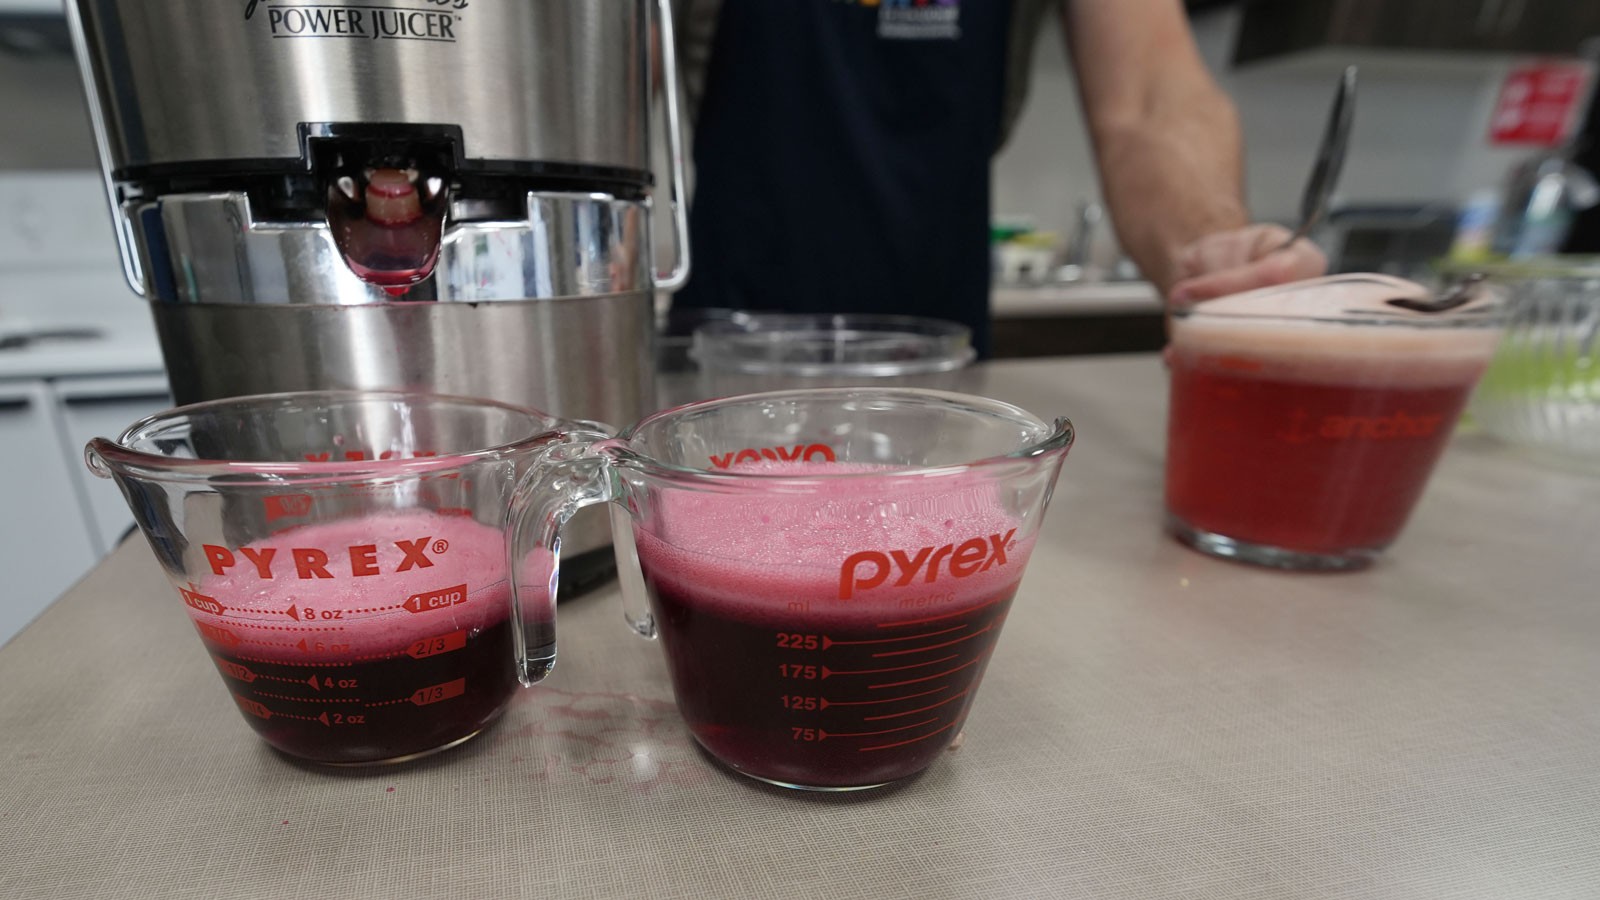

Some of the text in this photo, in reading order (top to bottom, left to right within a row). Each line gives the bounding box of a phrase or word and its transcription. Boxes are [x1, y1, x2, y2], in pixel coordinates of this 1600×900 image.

[268, 9, 365, 34] POWER
[194, 597, 220, 616] cup
[428, 589, 462, 607] cup
[898, 591, 956, 610] metric
[304, 608, 344, 620] 8 oz
[415, 638, 446, 656] 2/3
[776, 632, 818, 650] 225
[779, 663, 817, 680] 175
[324, 678, 358, 689] 4 oz
[418, 687, 444, 703] 1/3
[780, 695, 817, 711] 125
[333, 713, 365, 724] 2 oz
[791, 727, 815, 741] 75
